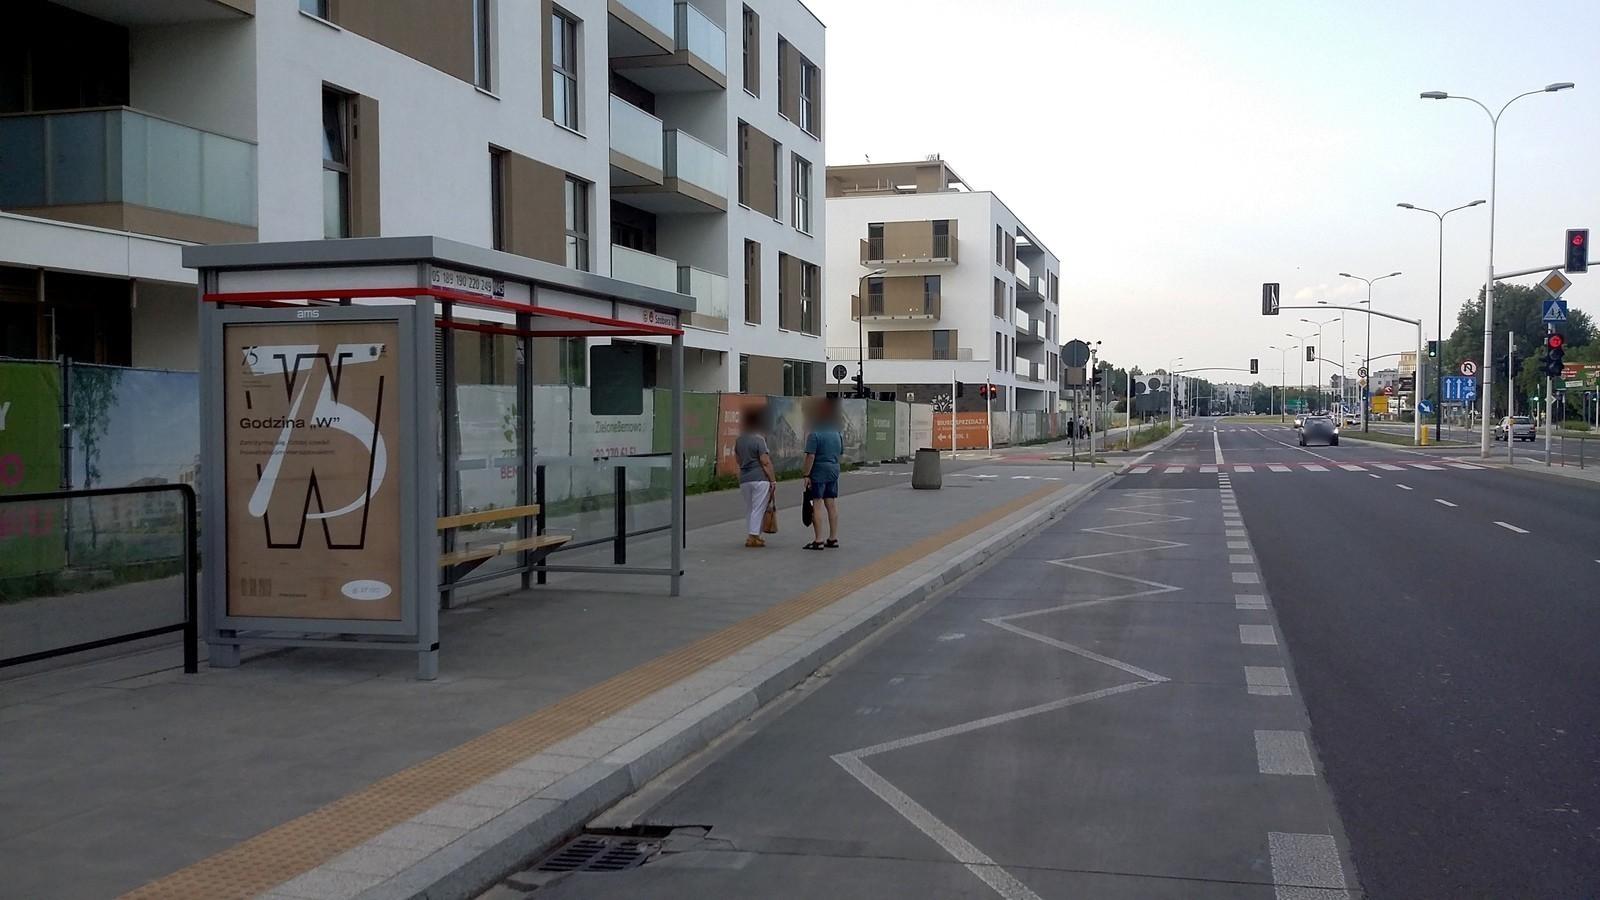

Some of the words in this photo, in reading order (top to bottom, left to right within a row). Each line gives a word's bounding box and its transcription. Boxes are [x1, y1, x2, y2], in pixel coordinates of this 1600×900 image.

[443, 272, 454, 285] 189
[456, 274, 467, 287] 190
[469, 277, 480, 290] 220
[296, 309, 320, 319] ams
[241, 346, 259, 366] 75
[239, 415, 305, 429] Godzina
